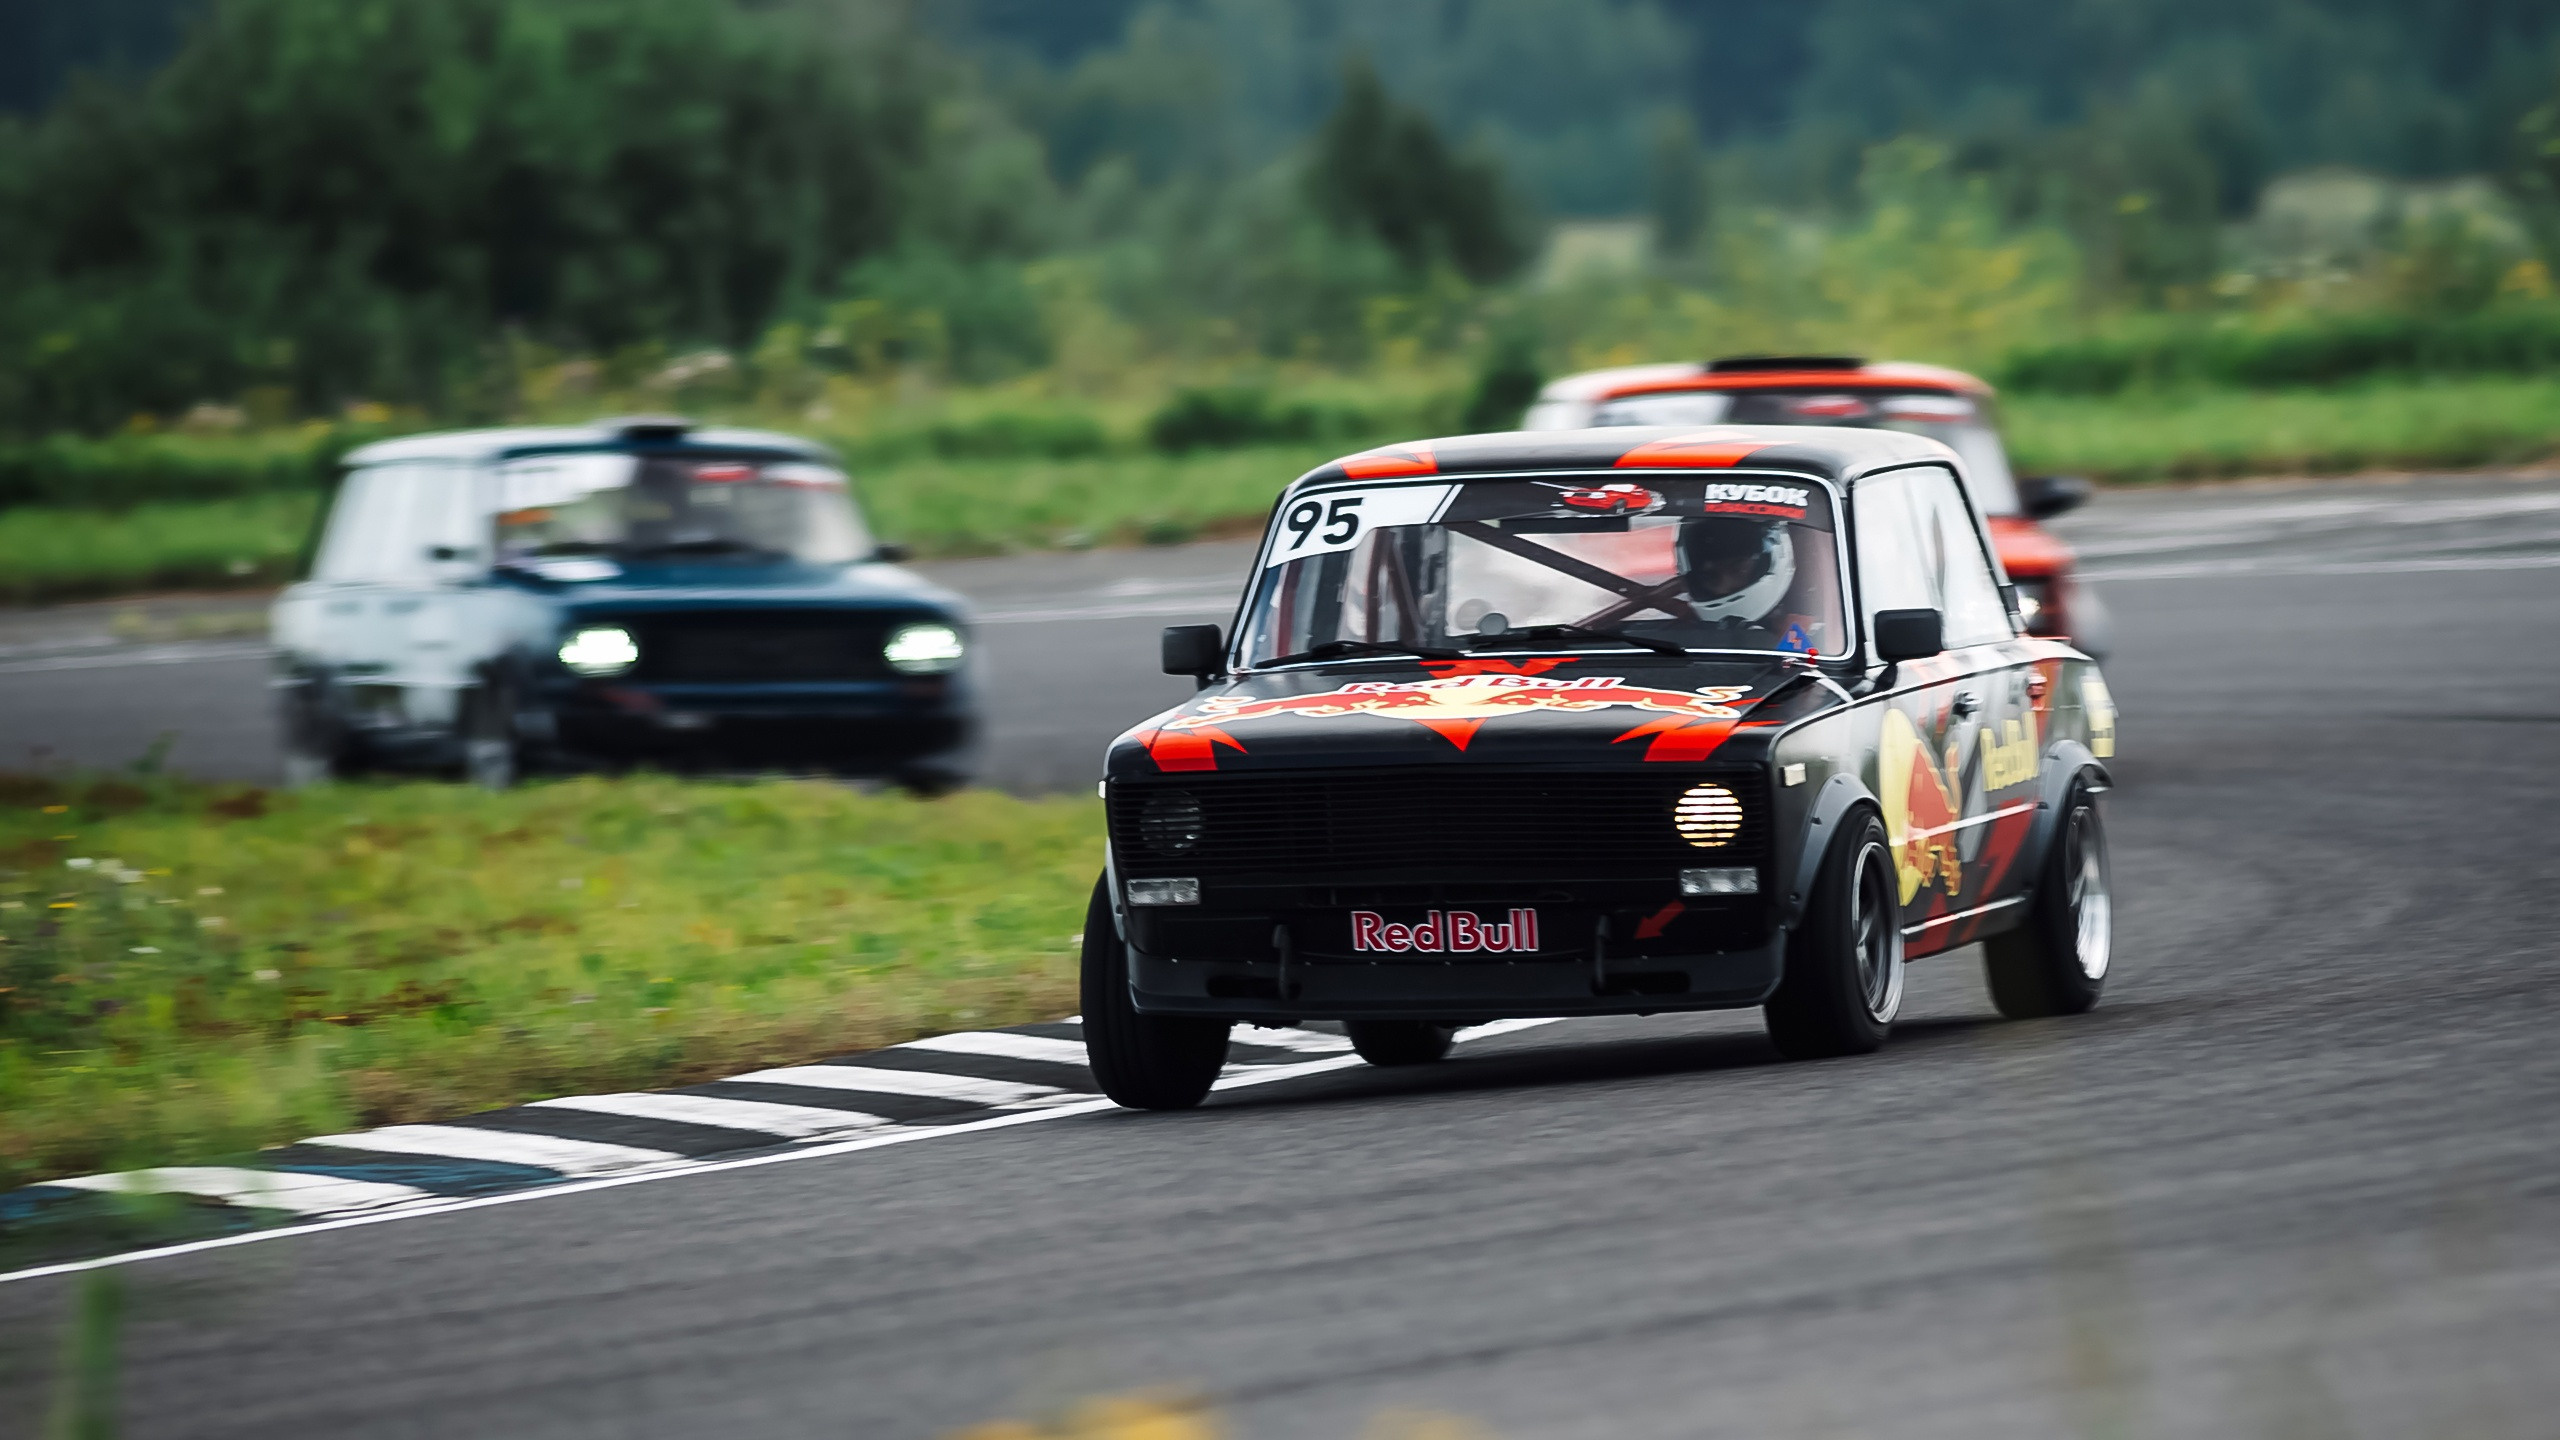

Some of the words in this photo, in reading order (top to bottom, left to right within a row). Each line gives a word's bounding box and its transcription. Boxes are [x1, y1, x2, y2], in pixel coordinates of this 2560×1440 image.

[1704, 484, 1809, 507] КУБОК
[1287, 497, 1364, 551] 95
[1342, 677, 1477, 694] Red
[1485, 676, 1618, 689] Bull
[1351, 910, 1445, 952] Red
[1447, 908, 1539, 952] Bull
